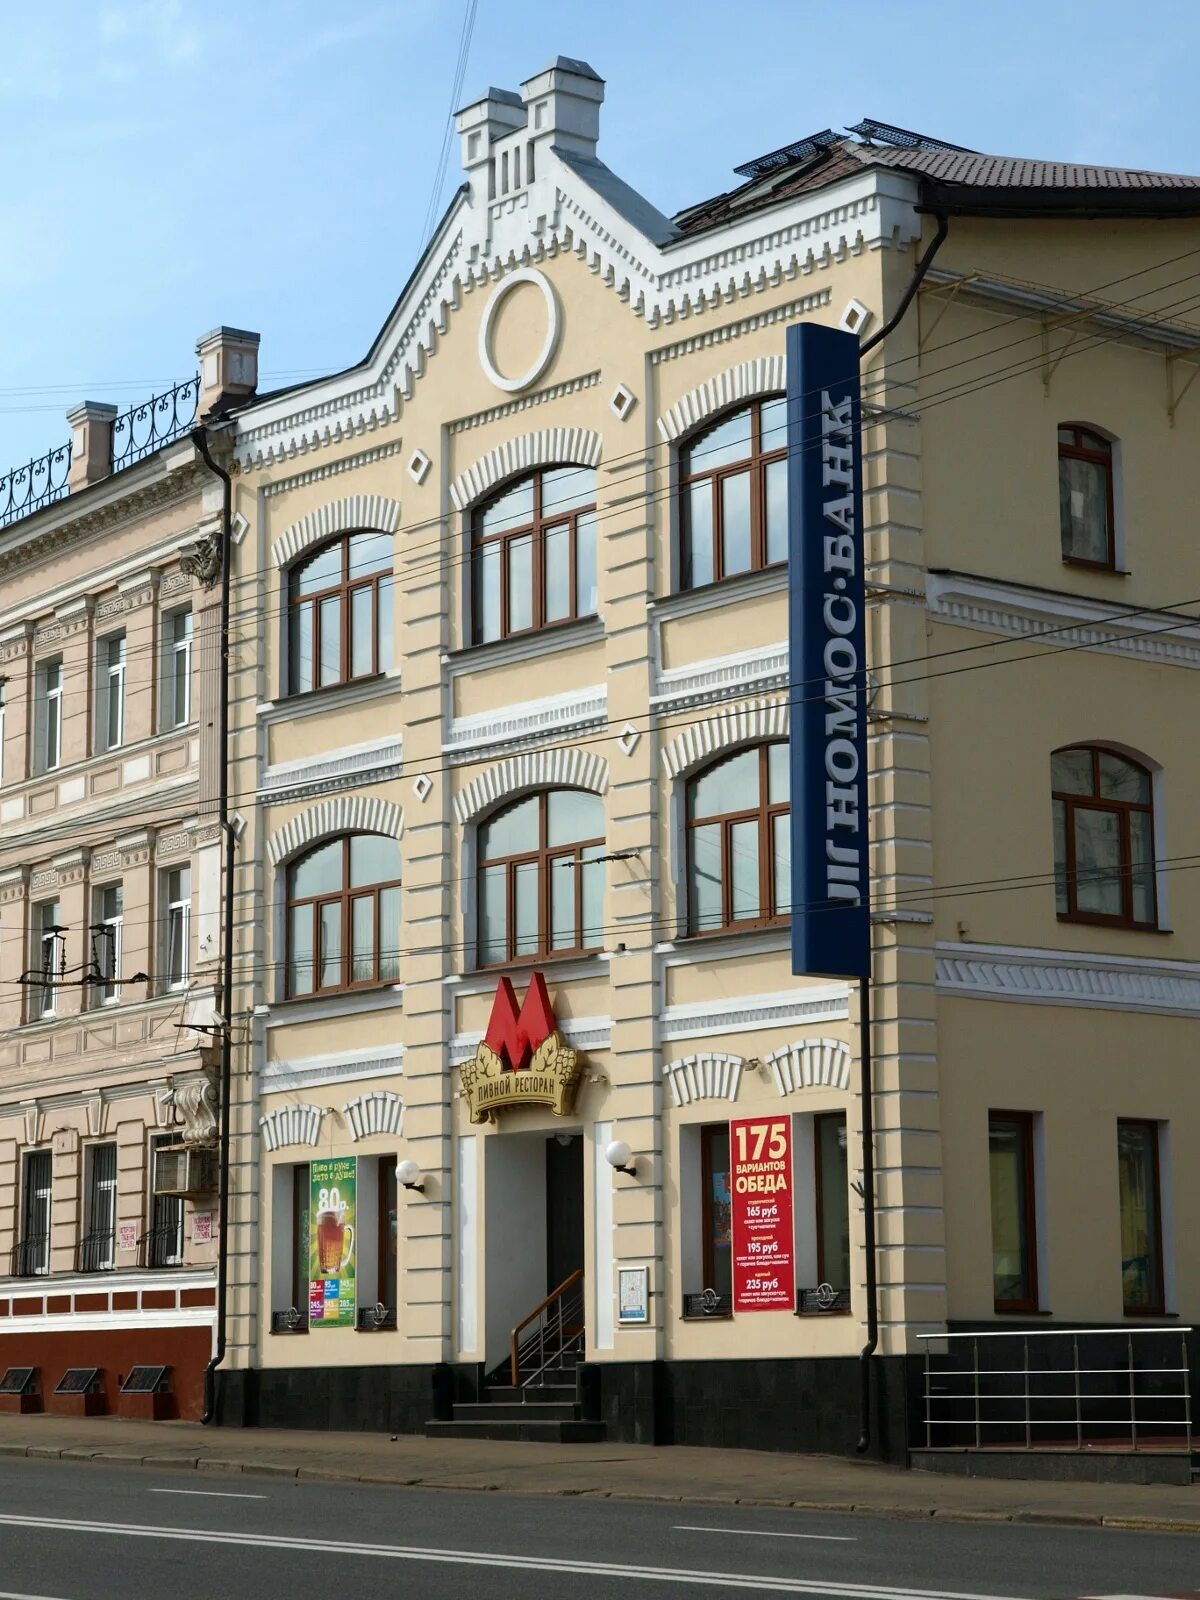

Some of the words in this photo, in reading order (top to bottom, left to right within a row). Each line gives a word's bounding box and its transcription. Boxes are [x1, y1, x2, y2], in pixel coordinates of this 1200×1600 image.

[478, 1076, 511, 1102] ПИВНОЙ
[515, 1075, 555, 1094] РЕСТОРАН
[735, 1123, 787, 1161] 175
[736, 1160, 786, 1174] ВАРИАНТОВ
[735, 1173, 787, 1194] ОБЕДА
[746, 1206, 760, 1217] 165
[762, 1204, 778, 1218] руб
[747, 1242, 761, 1253] 195
[762, 1241, 778, 1254] руб
[746, 1279, 761, 1289] 235
[762, 1278, 778, 1291] руб
